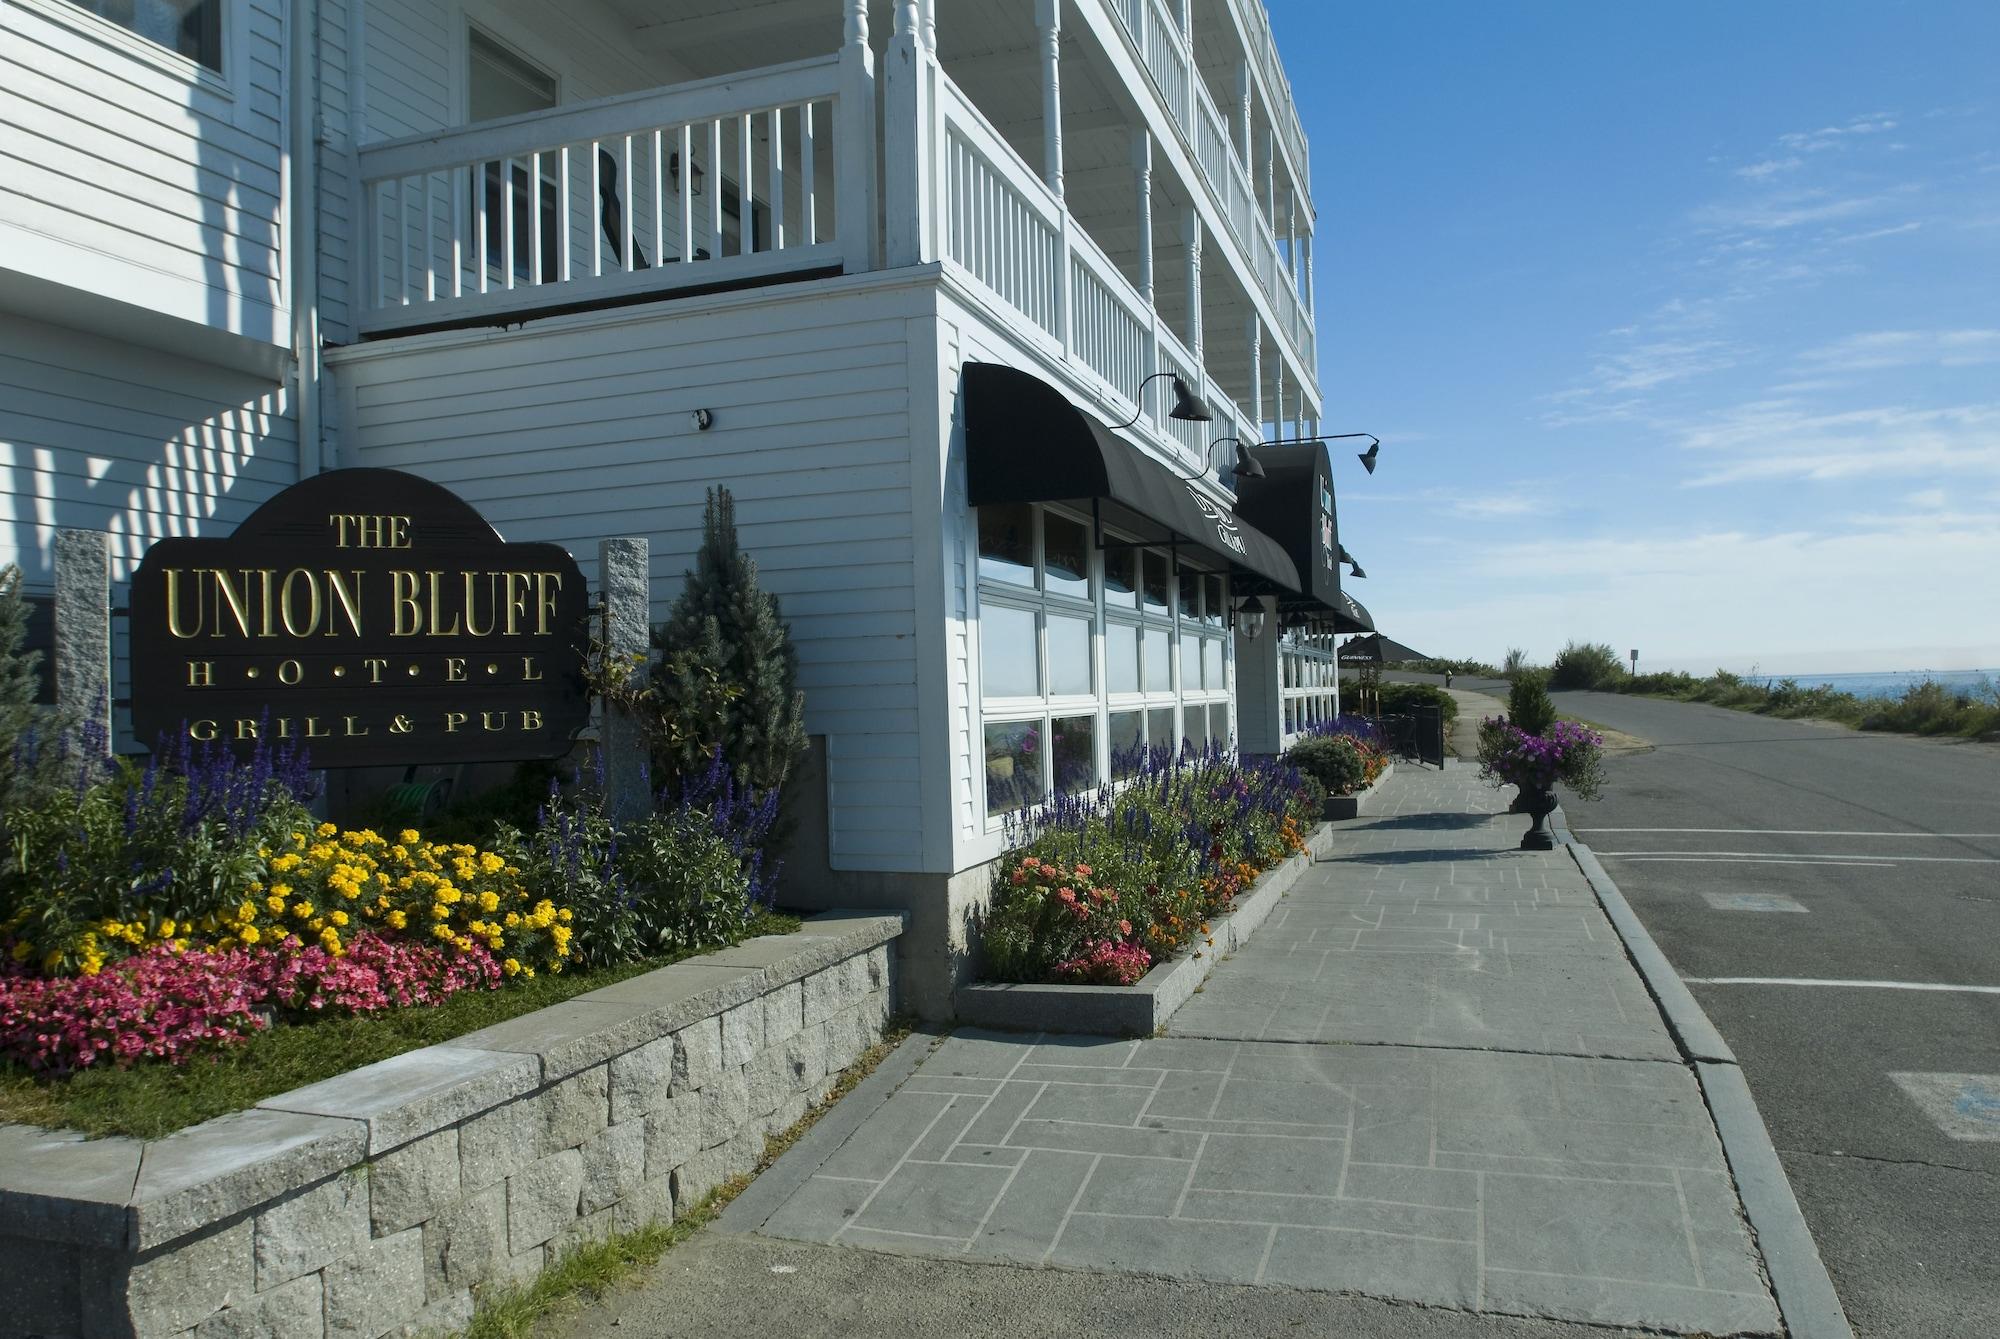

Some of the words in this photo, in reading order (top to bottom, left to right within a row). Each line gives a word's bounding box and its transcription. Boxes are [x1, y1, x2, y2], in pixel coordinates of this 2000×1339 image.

[329, 514, 412, 549] THE
[162, 567, 366, 639] UNION
[389, 570, 562, 637] BLUFF
[189, 715, 369, 741] GRILL
[389, 713, 415, 735] &
[444, 710, 544, 733] PUB
